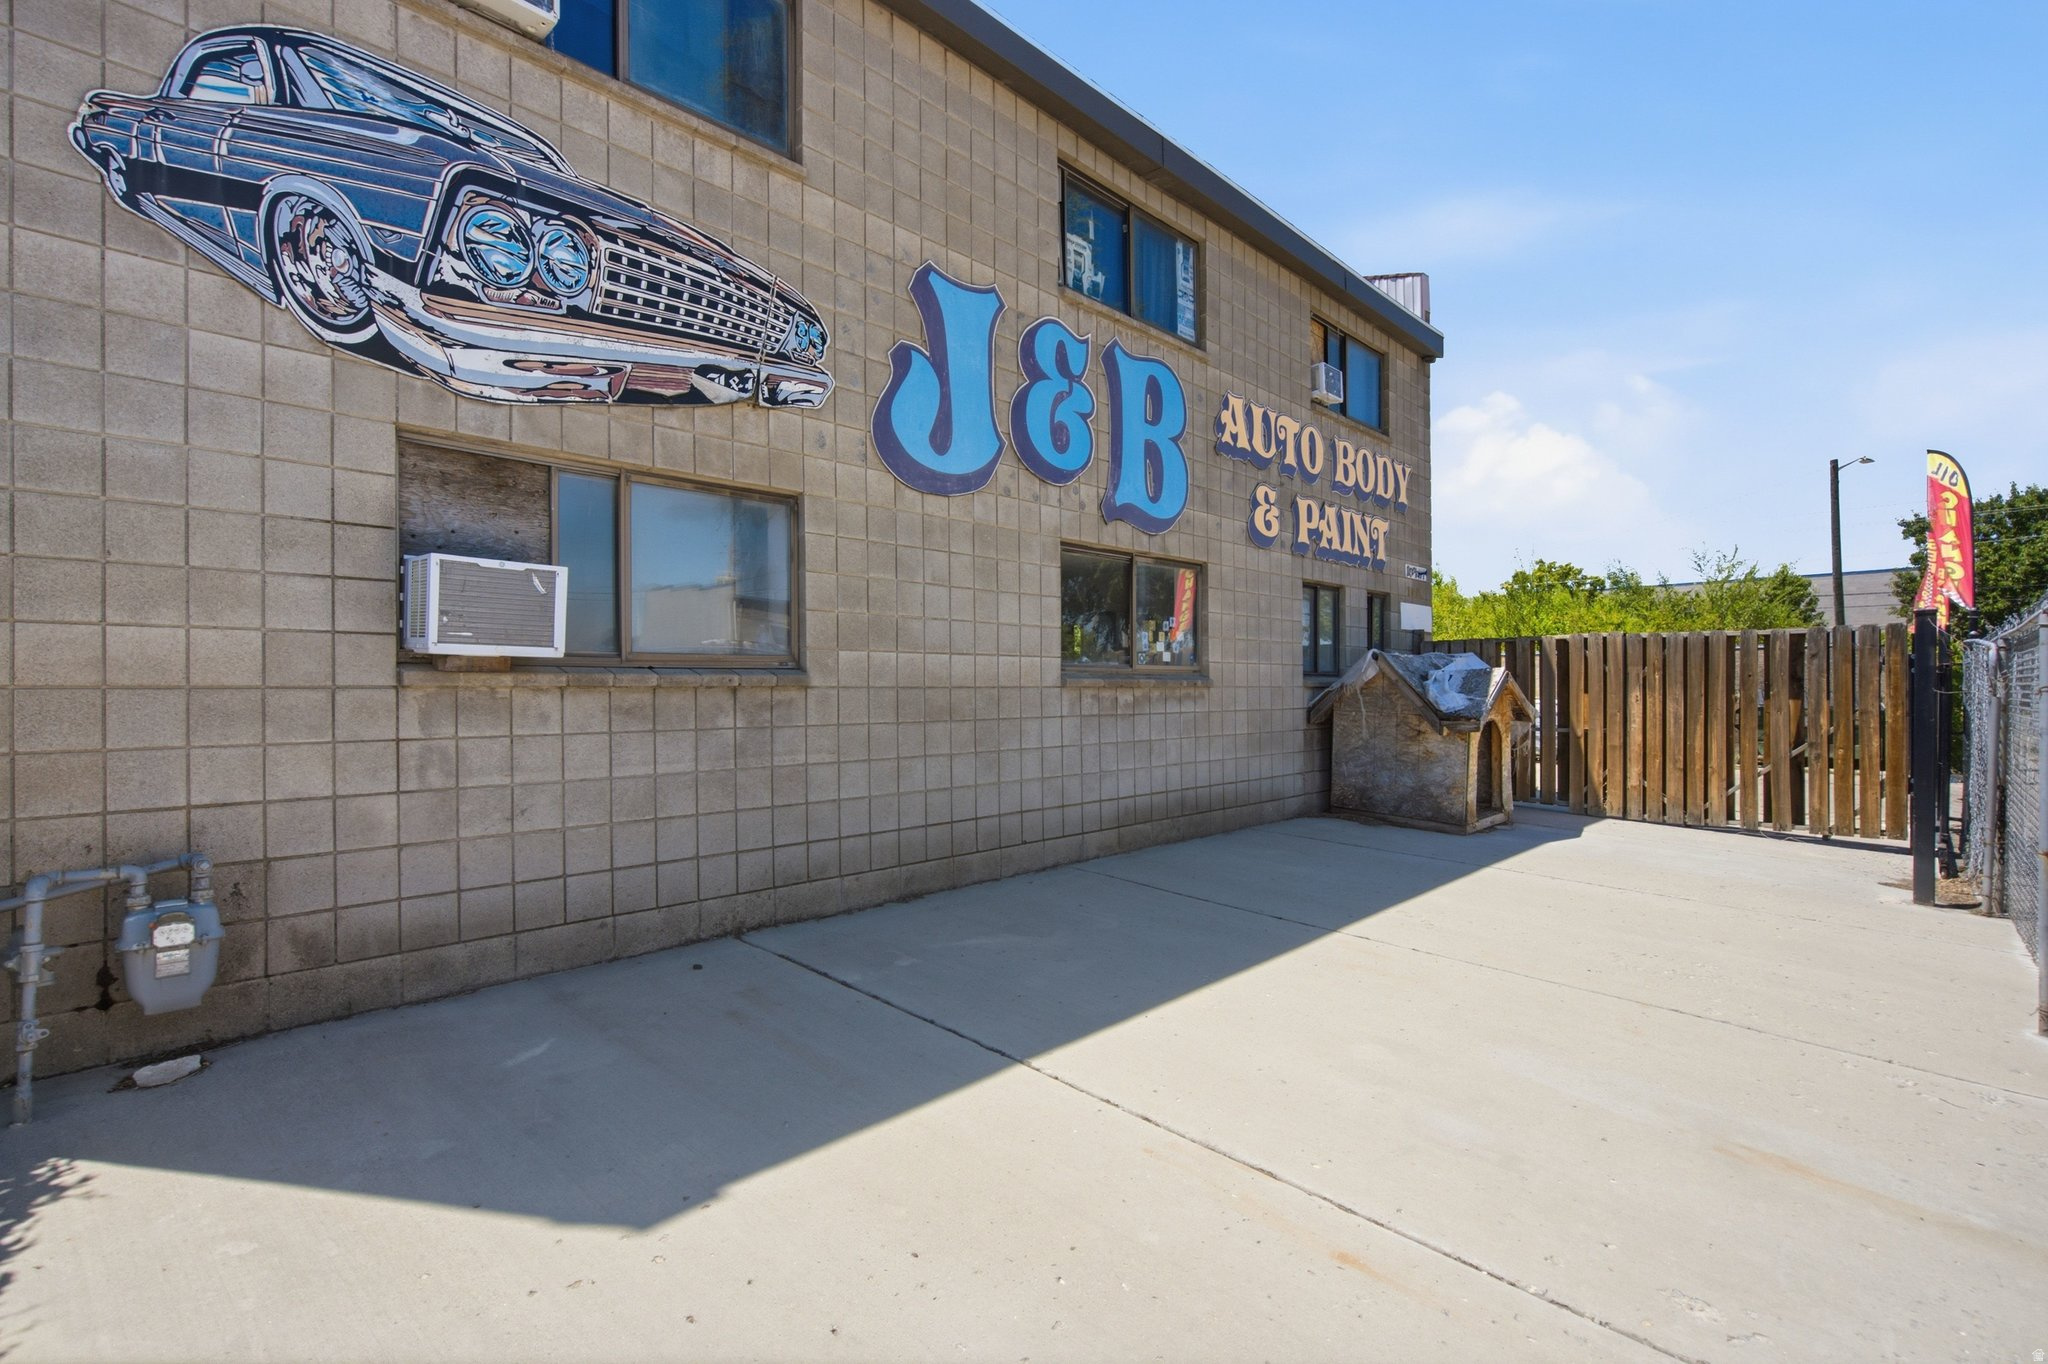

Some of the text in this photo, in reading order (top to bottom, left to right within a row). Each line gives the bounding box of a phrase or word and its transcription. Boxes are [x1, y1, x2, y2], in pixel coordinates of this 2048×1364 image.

[873, 261, 1188, 535] J & B
[1215, 391, 1412, 512] AUTO BODY
[1248, 482, 1389, 571] & PAINT
